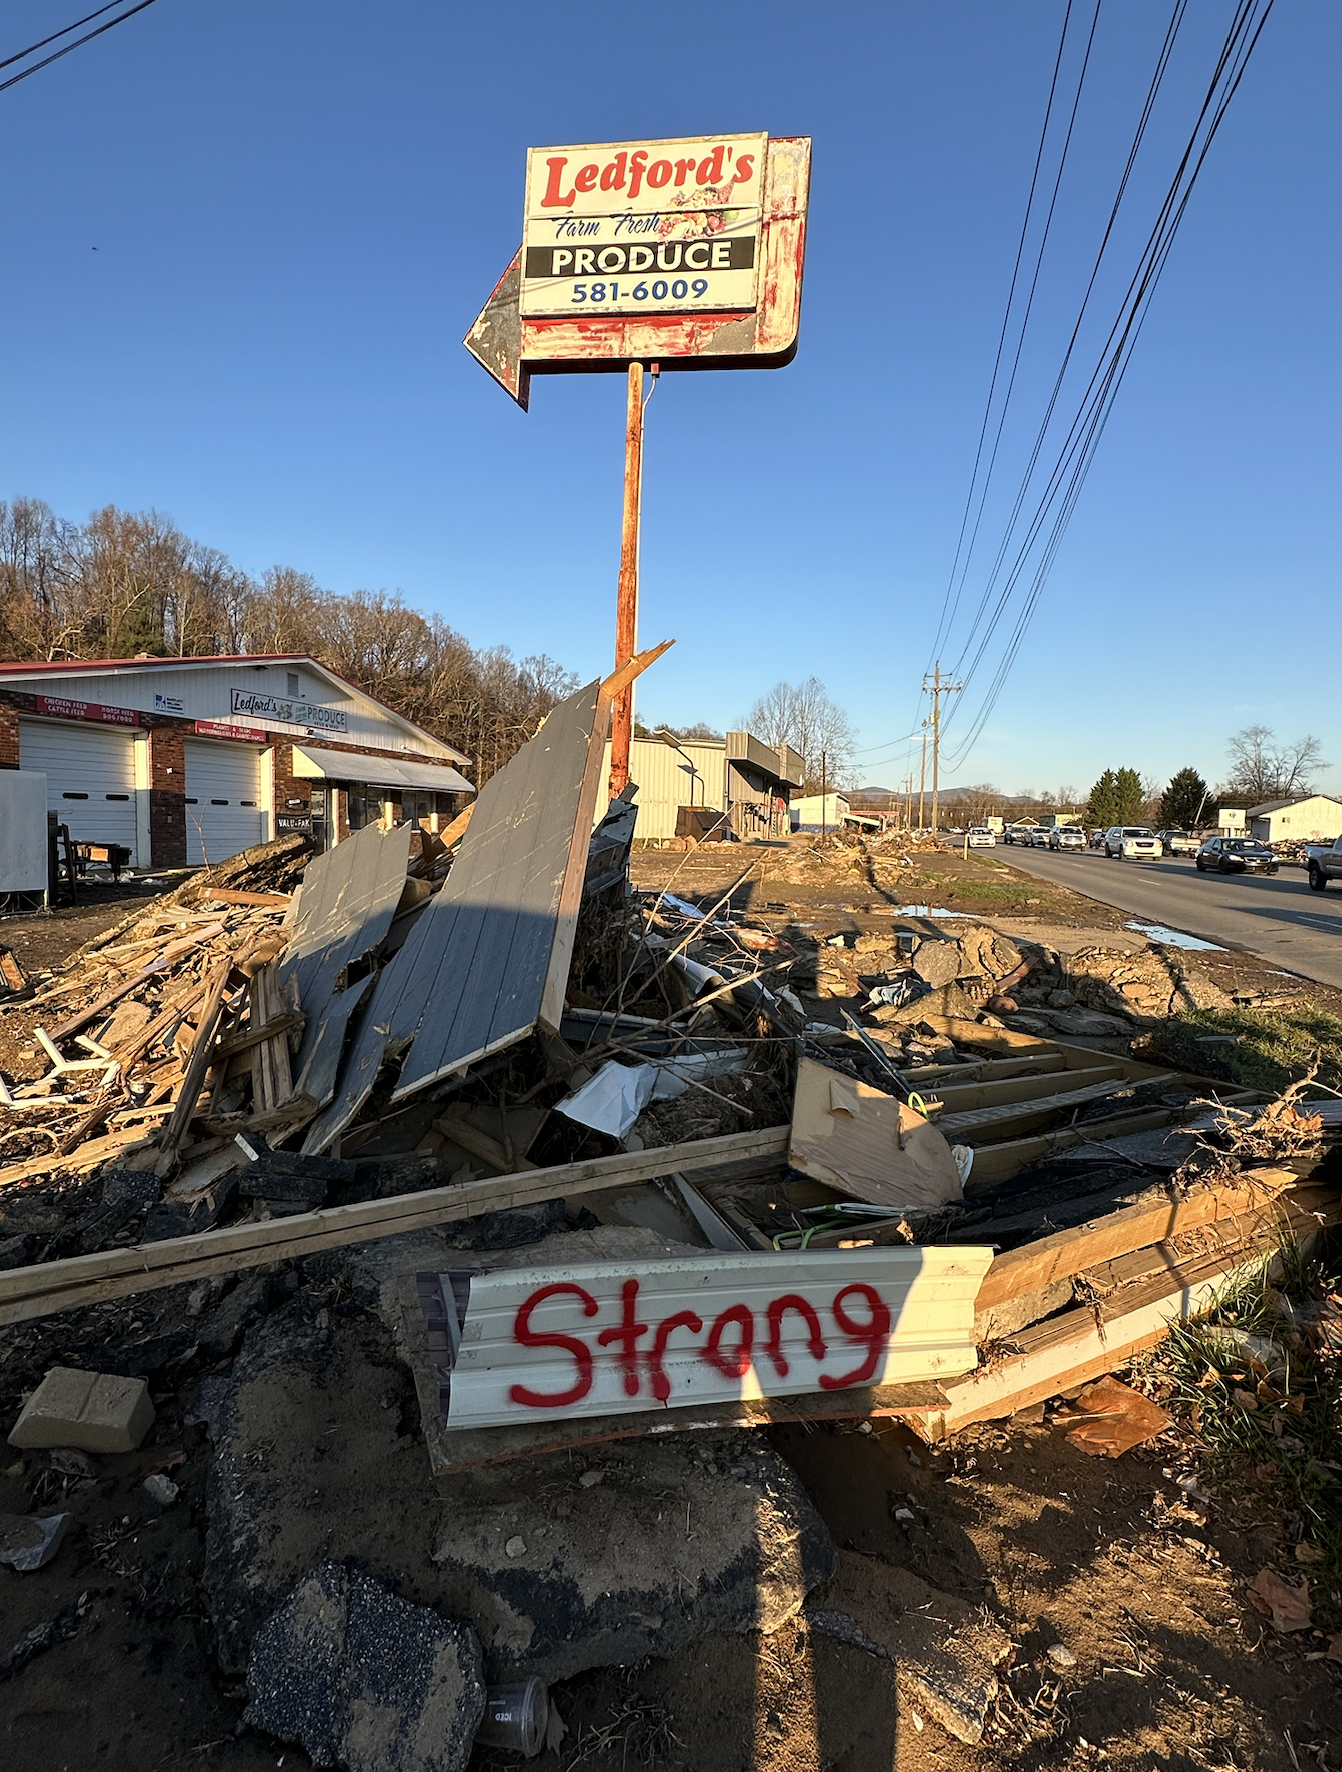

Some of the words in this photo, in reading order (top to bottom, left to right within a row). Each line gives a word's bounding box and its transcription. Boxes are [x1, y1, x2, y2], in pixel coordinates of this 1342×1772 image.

[541, 145, 755, 207] Ledford's
[550, 210, 600, 239] Farm
[609, 207, 660, 236] Fresh
[552, 241, 732, 275] PRODUCE
[571, 279, 709, 303] 581-6009
[44, 697, 71, 707] CHICKEN
[47, 705, 69, 714] CATTLE
[70, 708, 85, 716] FEED
[101, 706, 120, 715] HORSE
[234, 692, 277, 714] Ledford's
[307, 706, 345, 725] PRODUCE
[509, 1278, 890, 1408] Strong
